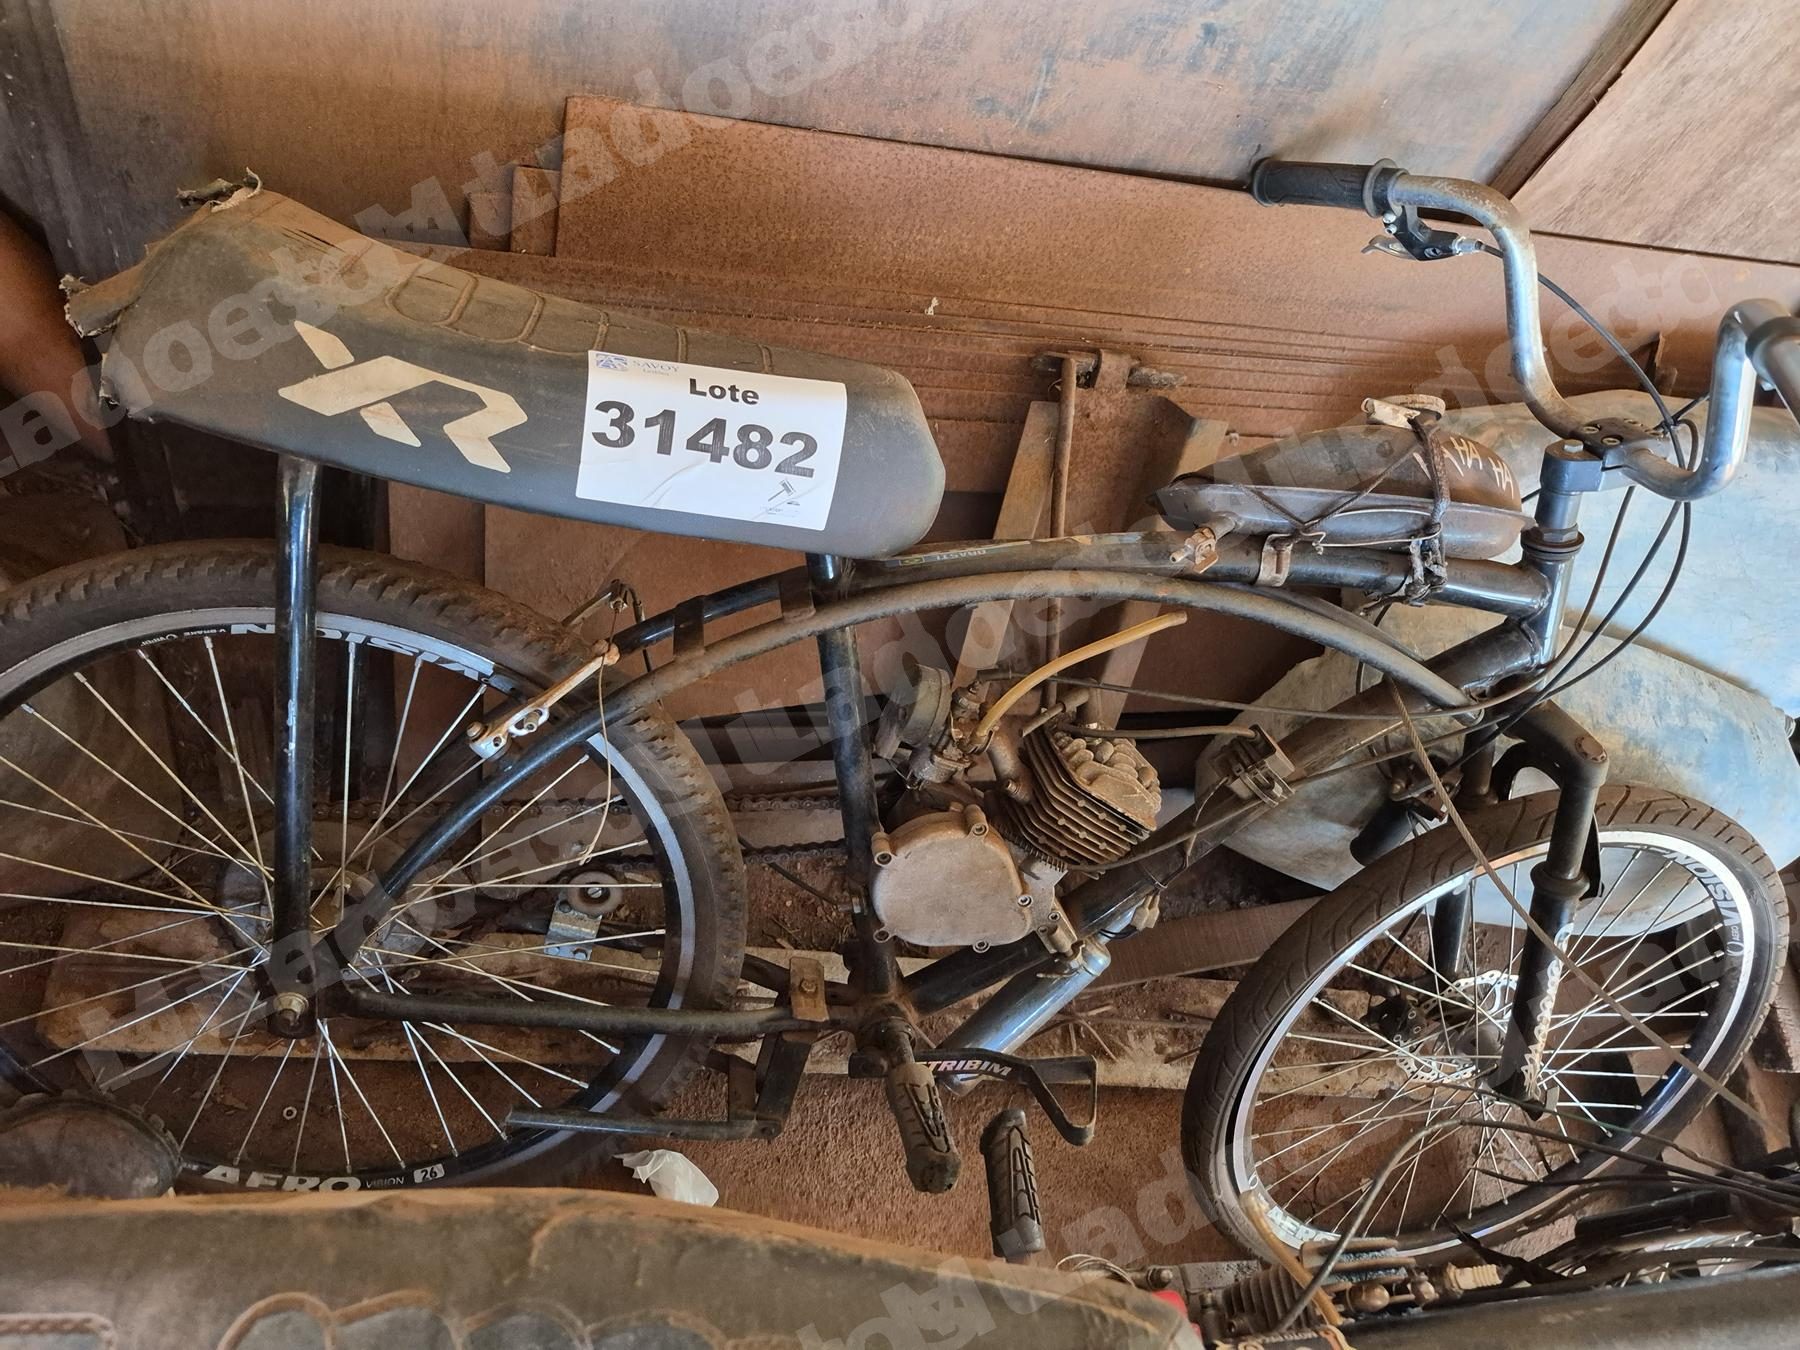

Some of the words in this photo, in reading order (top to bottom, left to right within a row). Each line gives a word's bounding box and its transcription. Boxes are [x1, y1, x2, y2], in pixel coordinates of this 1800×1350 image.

[689, 377, 760, 406] Lote
[591, 400, 818, 479] 31482
[1662, 850, 1742, 927] VISION
[419, 1165, 439, 1182] 26
